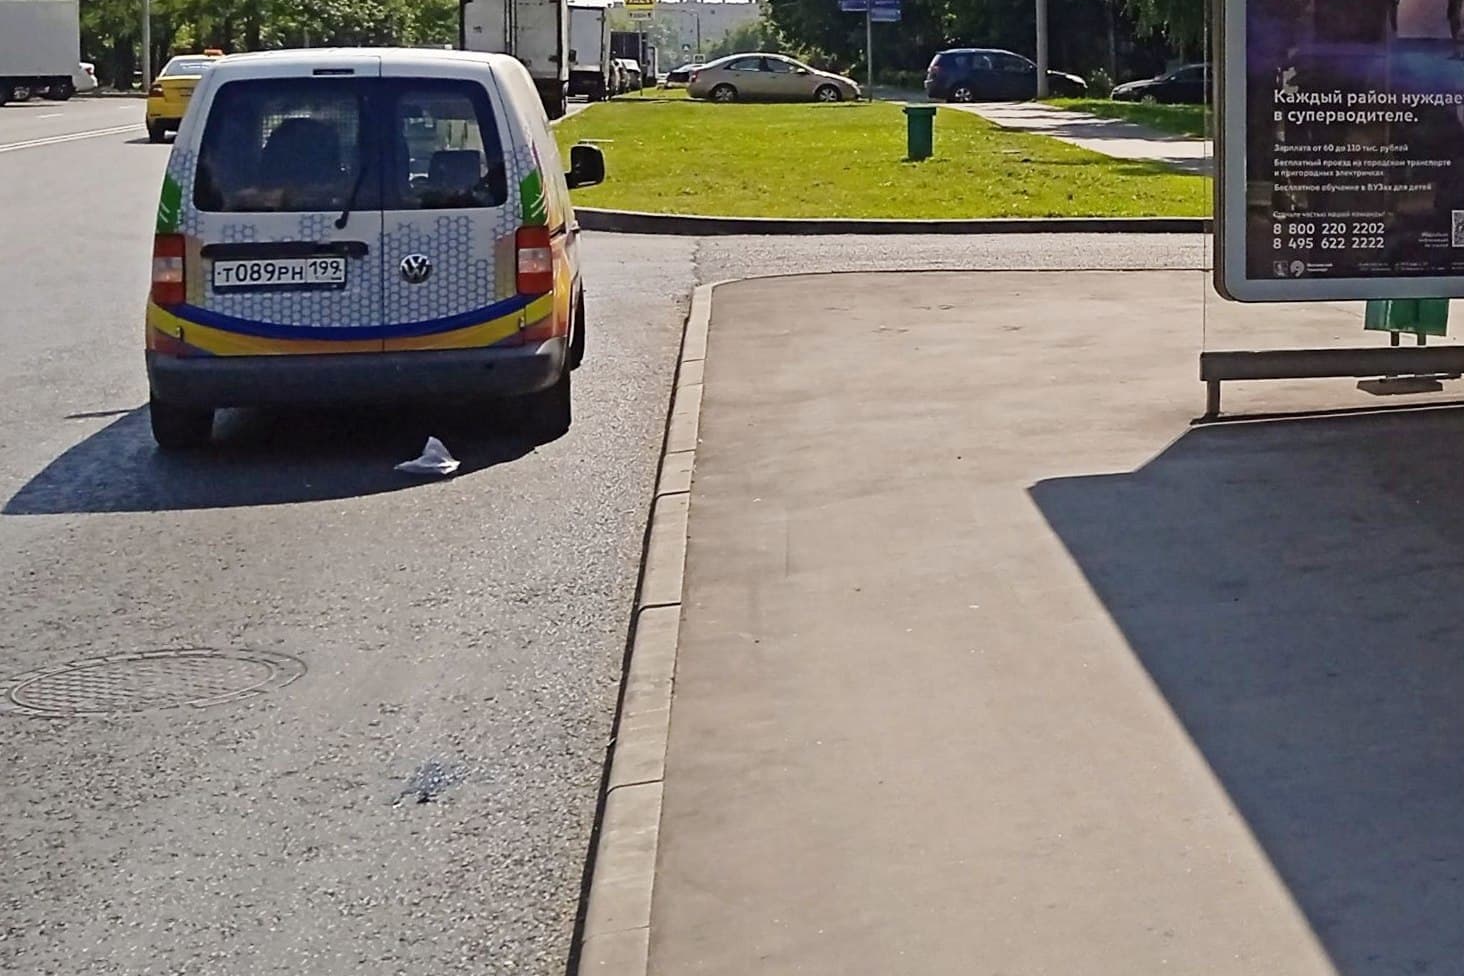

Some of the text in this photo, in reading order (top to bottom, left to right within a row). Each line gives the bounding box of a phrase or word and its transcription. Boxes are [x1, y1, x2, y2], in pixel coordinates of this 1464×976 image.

[1273, 89, 1343, 106] Каждый
[1347, 90, 1398, 107] район
[1273, 110, 1419, 125] в суперводителе.
[1274, 144, 1312, 153] Зарплата
[1322, 144, 1334, 152] 60
[1335, 145, 1346, 153] до
[1347, 144, 1361, 152] 110
[1380, 144, 1409, 154] рублей
[1274, 158, 1322, 167] Бесплатный
[1407, 160, 1452, 168] транспорте
[1274, 183, 1320, 192] Бесплатное
[1272, 223, 1385, 235] 8 800 220 2202
[1272, 237, 1385, 249] 8 495 622 2222
[308, 260, 341, 276] 199
